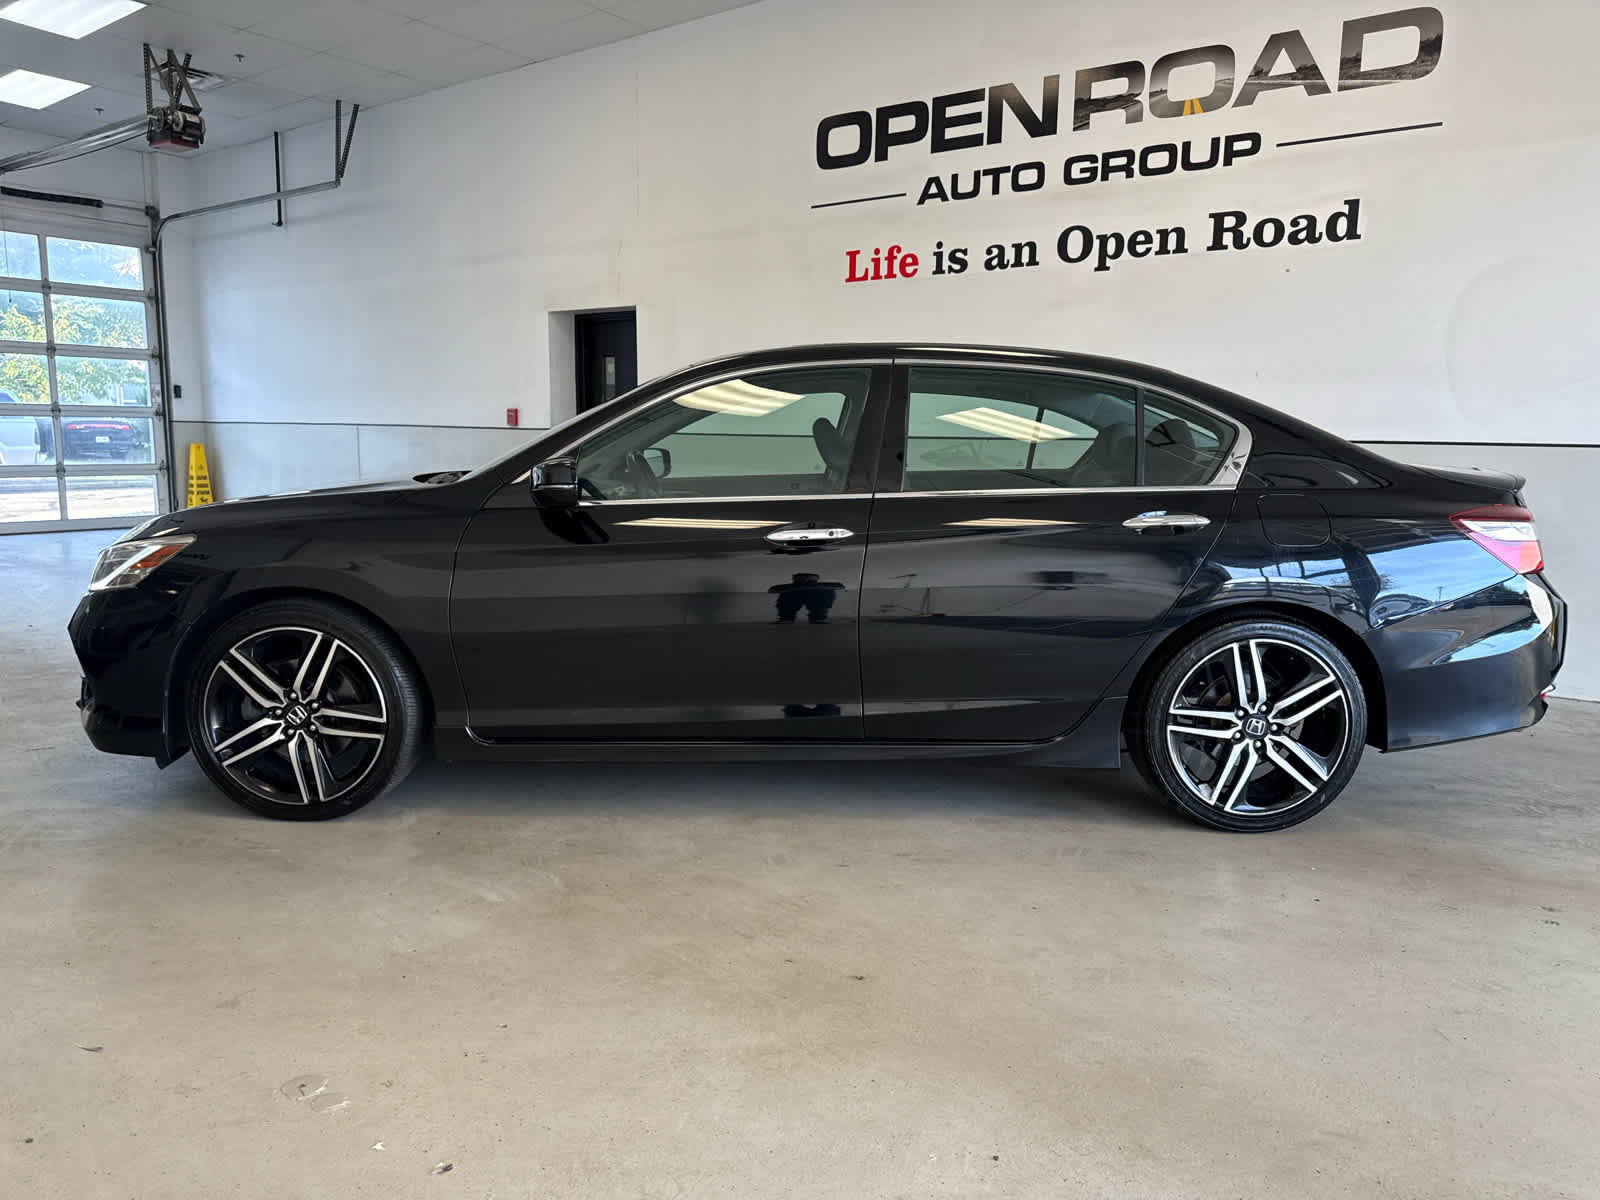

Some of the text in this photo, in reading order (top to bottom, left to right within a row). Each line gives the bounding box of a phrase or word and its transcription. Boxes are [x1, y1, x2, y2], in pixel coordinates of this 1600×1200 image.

[816, 7, 1444, 170] OPEN ROAD
[916, 132, 1262, 206] AUTO GROUP
[845, 198, 1361, 283] Life is an Open Road
